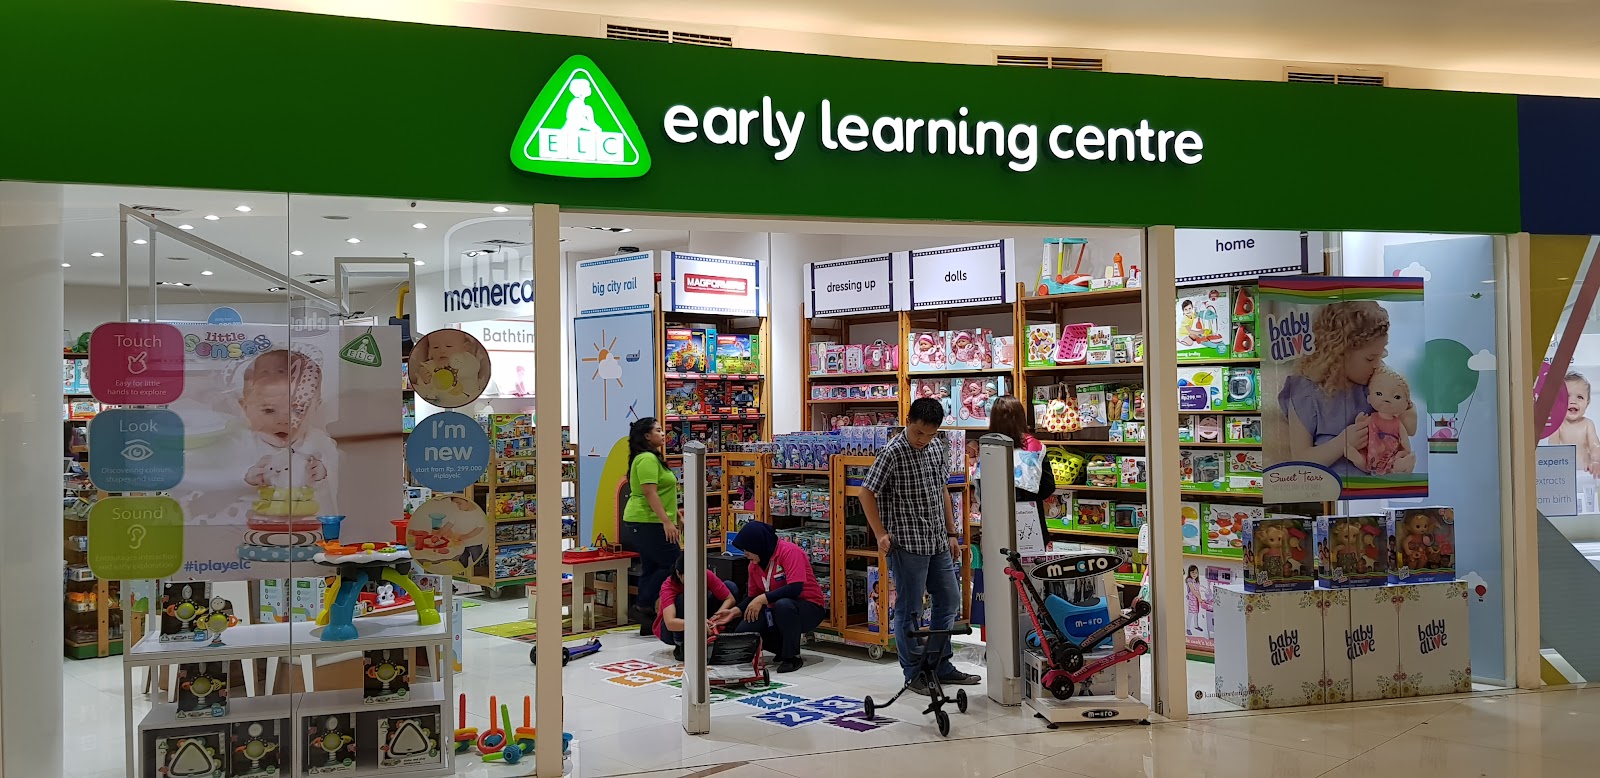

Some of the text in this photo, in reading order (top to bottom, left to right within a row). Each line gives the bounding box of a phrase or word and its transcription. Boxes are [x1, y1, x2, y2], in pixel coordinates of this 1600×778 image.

[663, 95, 1205, 174] early learning centre
[548, 134, 617, 155] ELC
[1215, 238, 1255, 252] home
[944, 270, 967, 282] dolls
[592, 276, 637, 296] big city rail
[826, 278, 876, 293] dressing up
[1268, 311, 1310, 342] baby
[114, 334, 163, 348] Touch
[204, 331, 246, 343] little
[120, 420, 158, 432] Look
[424, 446, 473, 462] new
[1538, 458, 1569, 468] experts
[1270, 470, 1324, 483] Sweet Tears
[1552, 495, 1572, 503] birth
[112, 507, 163, 520] Sound
[184, 559, 251, 573] #iplayelc
[1345, 624, 1373, 646] baby
[1418, 618, 1446, 642] baby
[1268, 629, 1298, 652] baby
[776, 711, 814, 722] 2
